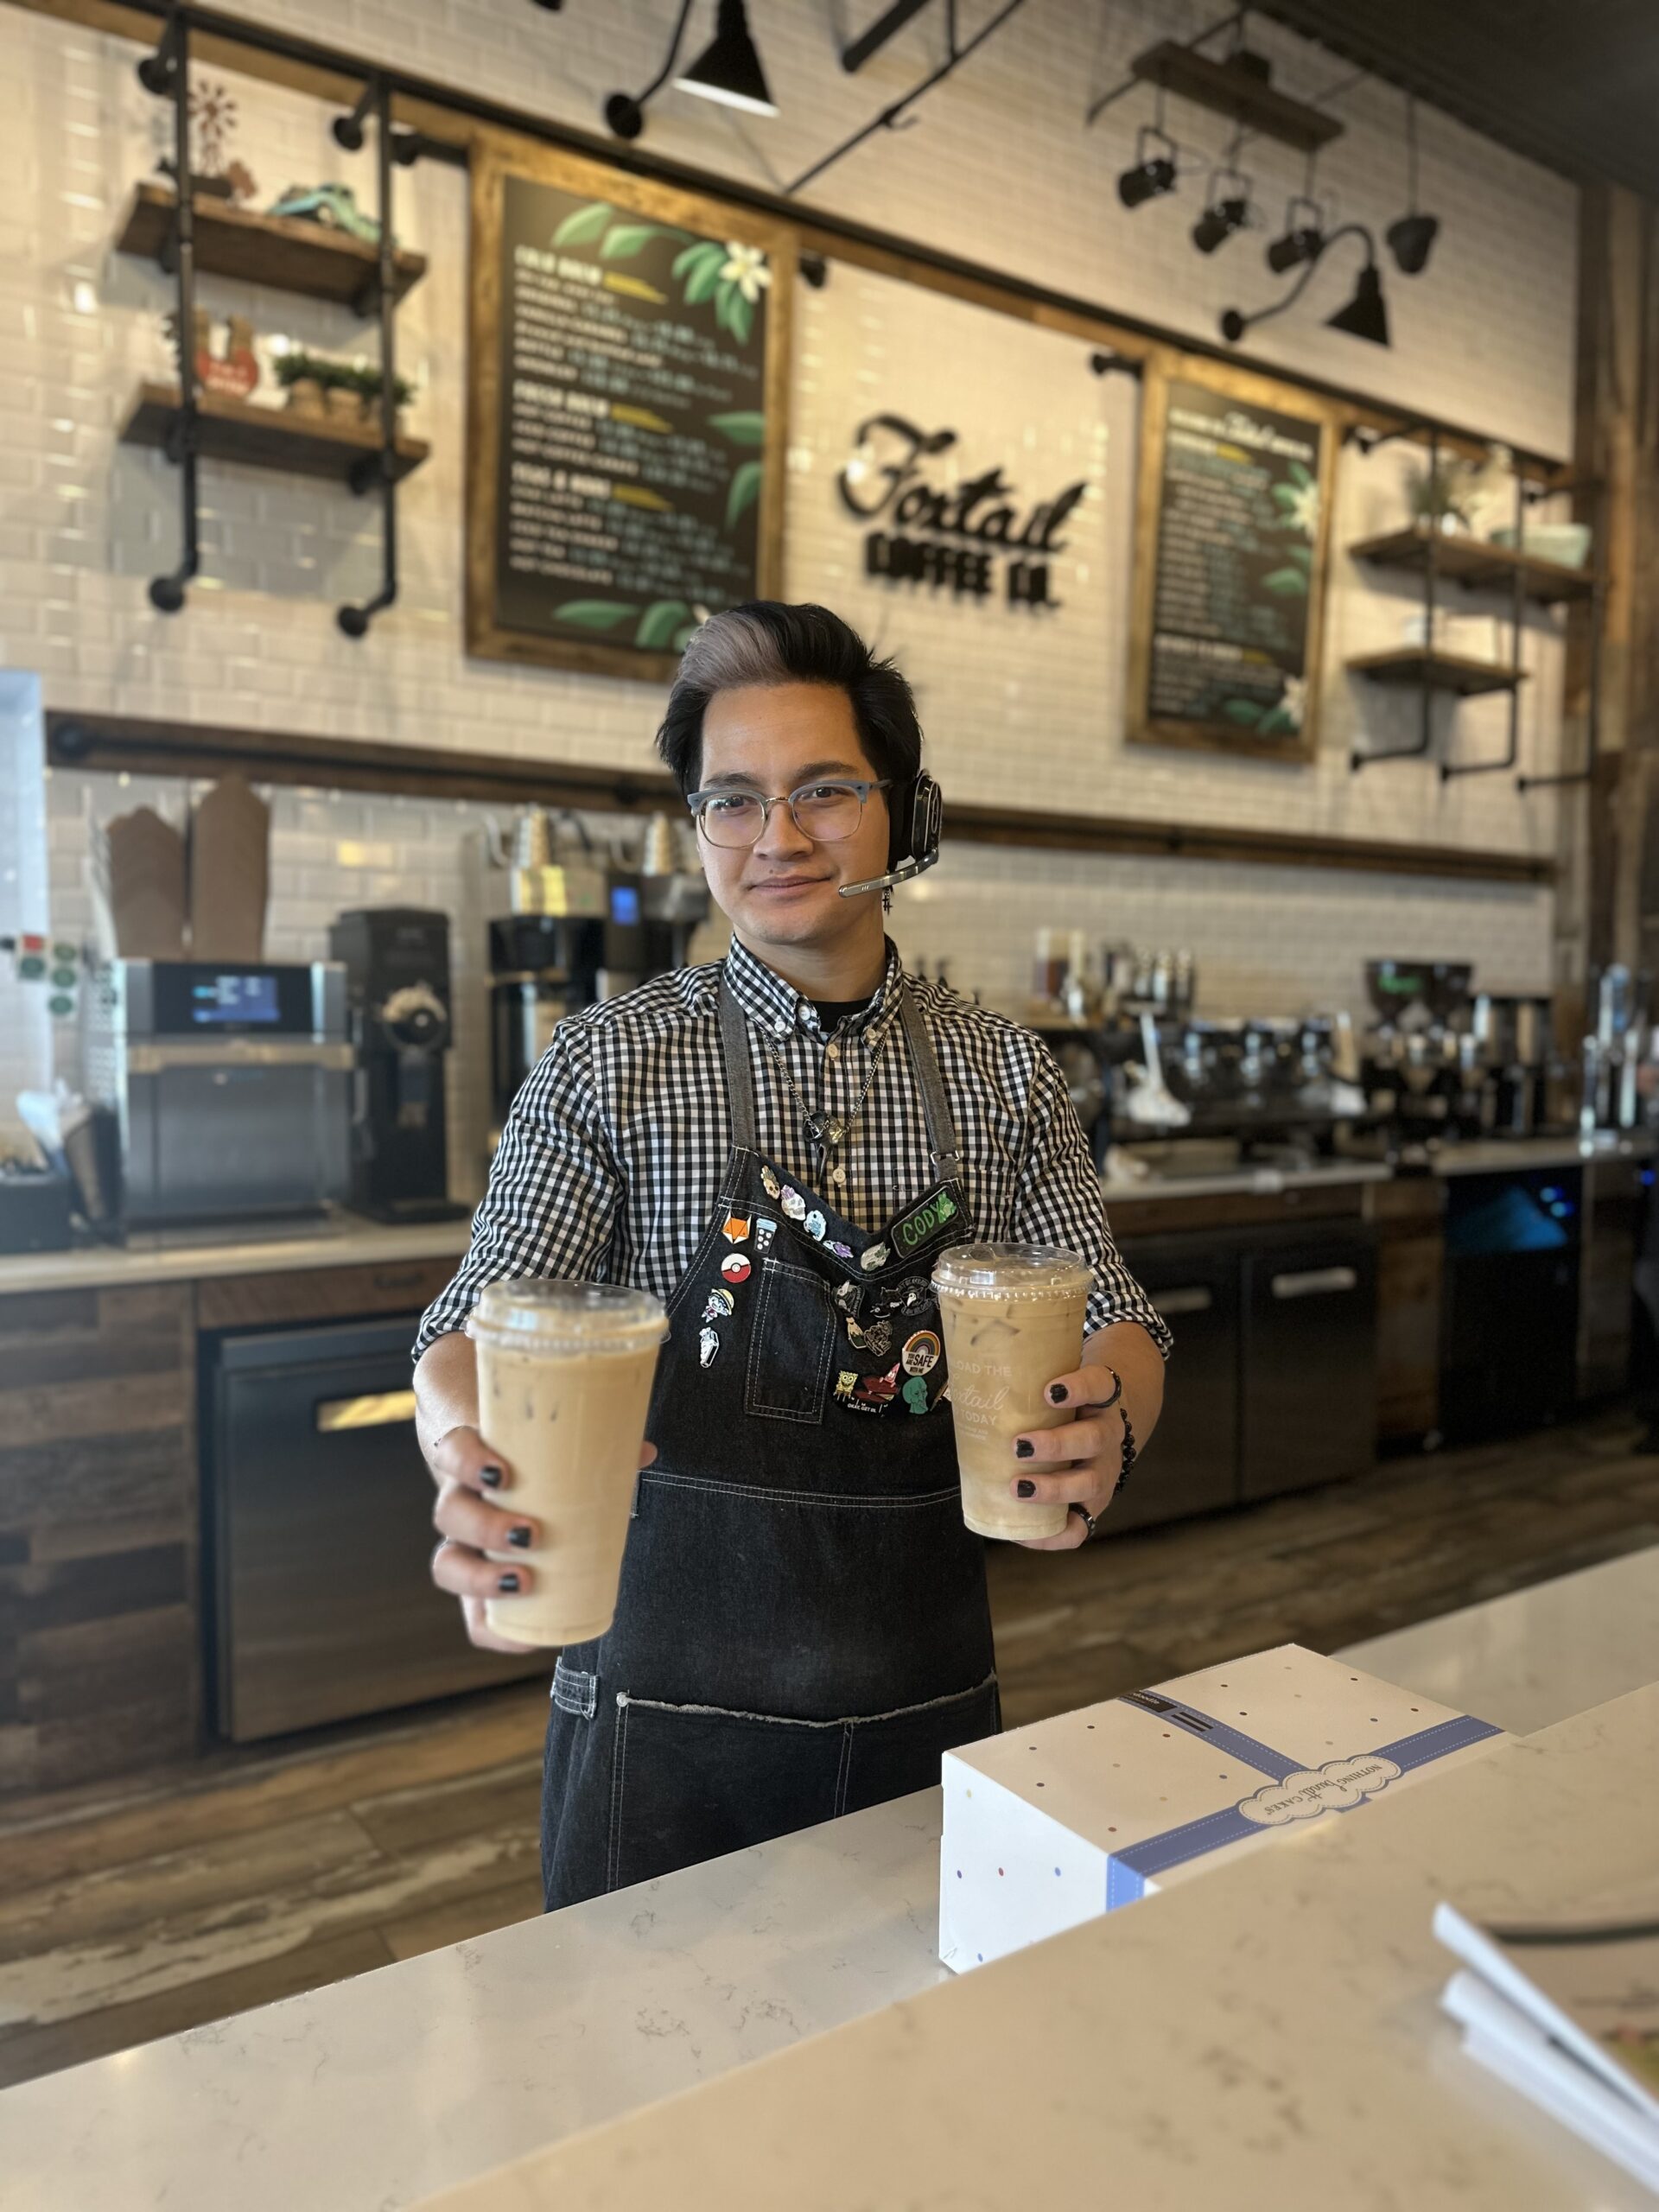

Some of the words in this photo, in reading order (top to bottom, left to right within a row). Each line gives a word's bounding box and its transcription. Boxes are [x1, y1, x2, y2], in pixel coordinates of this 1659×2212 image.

[903, 1201, 944, 1245] CODY
[913, 1354, 933, 1367] SAFE
[984, 1365, 1012, 1376] THE
[961, 1409, 997, 1426] TODAY
[1337, 1764, 1382, 1784] NOTHING
[1264, 1796, 1303, 1815] CAKES
